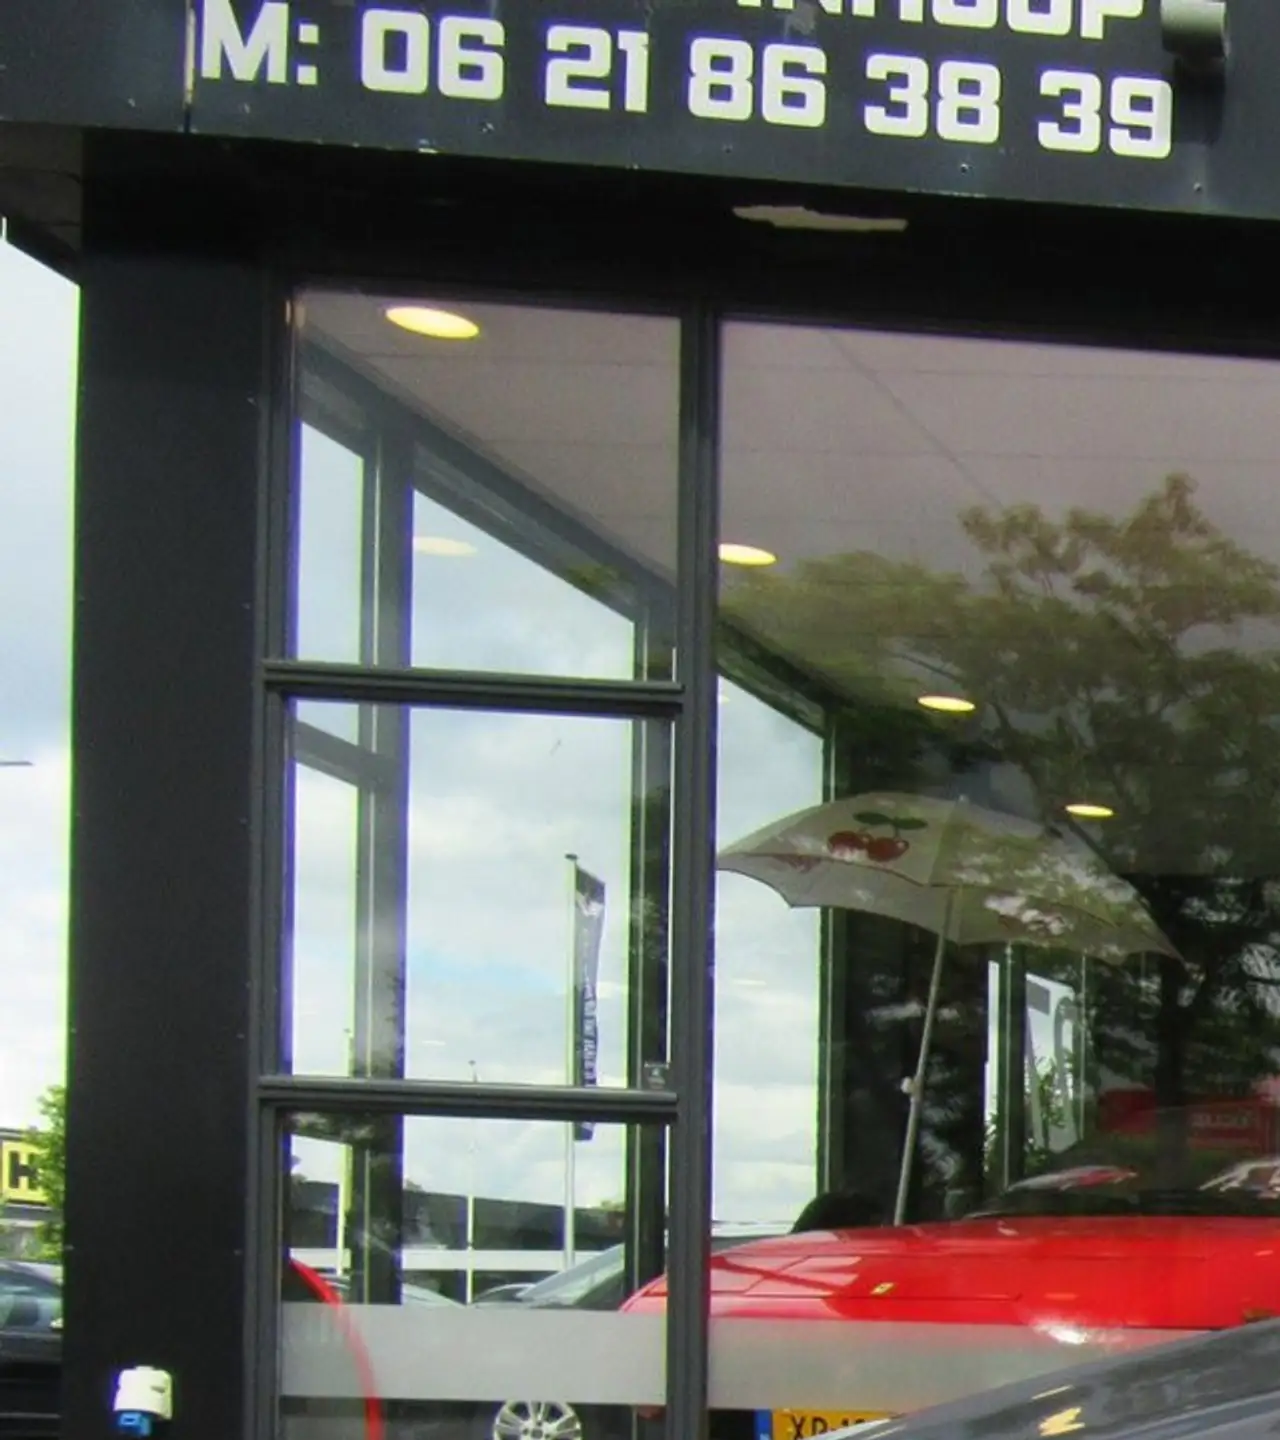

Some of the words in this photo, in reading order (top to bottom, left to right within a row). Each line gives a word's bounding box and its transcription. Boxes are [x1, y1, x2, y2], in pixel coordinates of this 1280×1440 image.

[201, 0, 318, 85] M:
[361, 9, 505, 100] 06
[545, 25, 649, 112] 21
[688, 37, 827, 127] 86
[864, 53, 1001, 143] 38
[1037, 69, 1172, 158] 39
